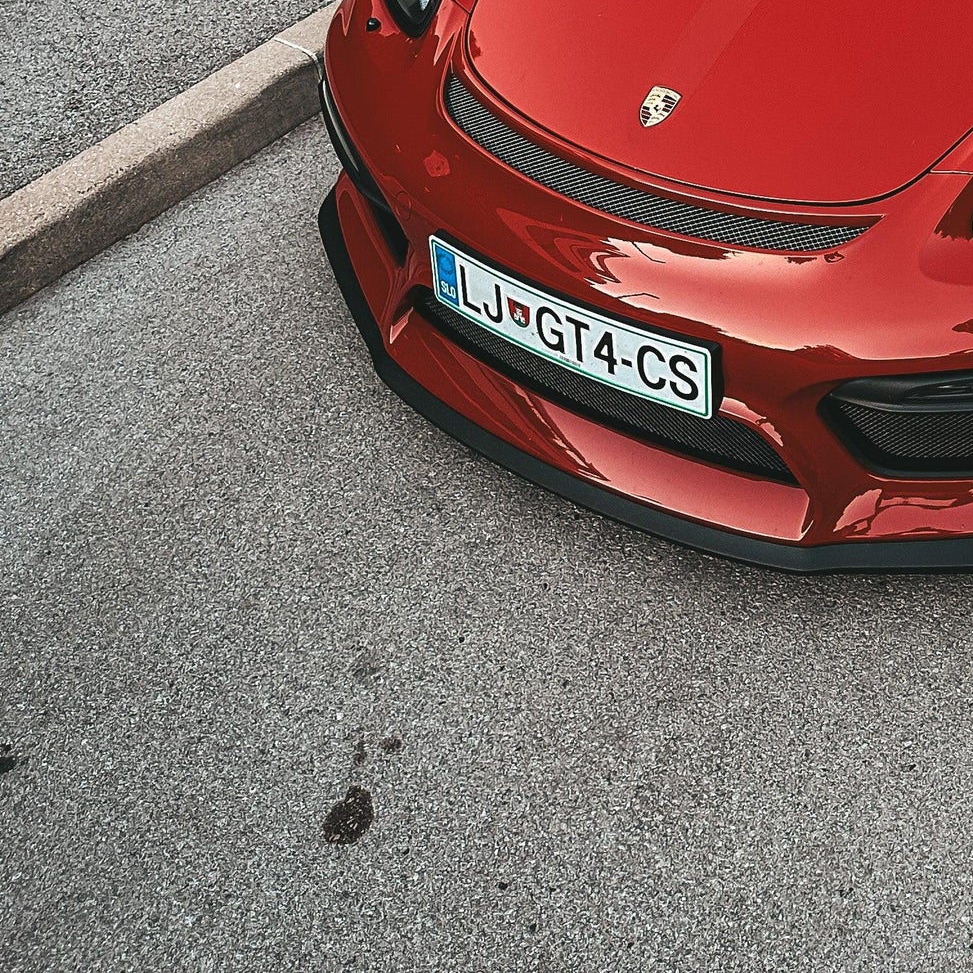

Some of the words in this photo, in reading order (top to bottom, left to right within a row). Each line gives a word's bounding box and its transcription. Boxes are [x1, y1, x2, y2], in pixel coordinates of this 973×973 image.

[440, 280, 457, 299] SLO
[459, 264, 502, 324] LJ
[536, 306, 699, 401] GT4-CS
